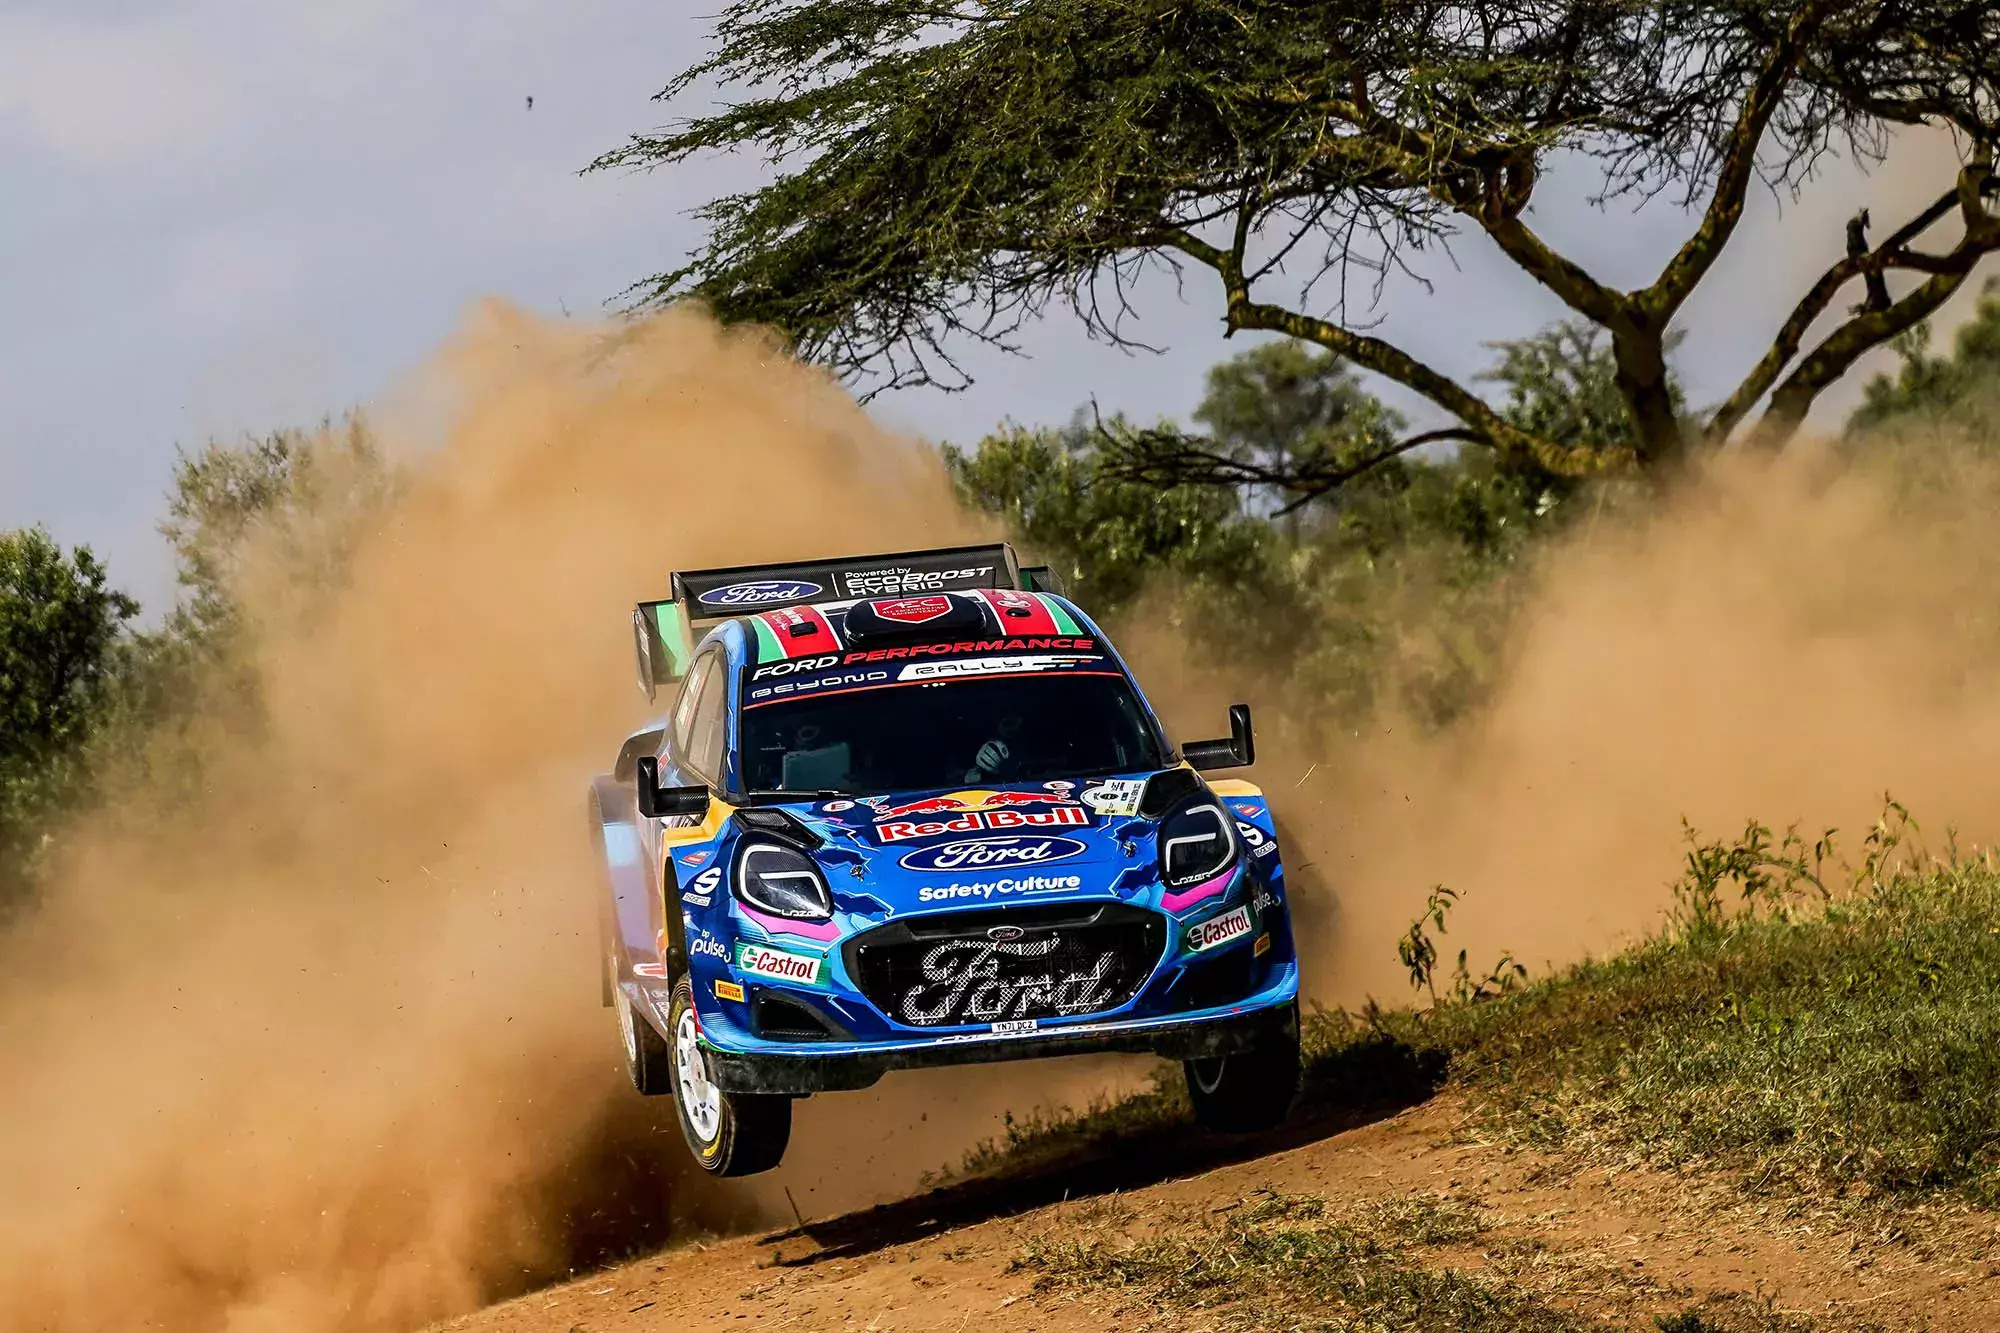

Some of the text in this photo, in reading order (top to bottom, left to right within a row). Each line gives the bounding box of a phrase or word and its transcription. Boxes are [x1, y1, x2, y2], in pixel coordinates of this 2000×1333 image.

[845, 567, 911, 578] Powered by
[845, 566, 994, 588] ECOBOOST
[720, 584, 800, 603] Ford
[850, 580, 944, 596] HYBRID
[752, 639, 1094, 681] FORD PERFORMANCE
[752, 660, 1023, 699] BEYOND RALLY
[876, 807, 1089, 842] Red Bull
[934, 838, 1053, 868] Ford
[919, 875, 1081, 902] SafetyCulture
[701, 928, 710, 938] bp
[1203, 910, 1250, 945] Castrol
[690, 936, 726, 959] pulse
[756, 951, 816, 980] Castrol
[903, 938, 1114, 1025] Ford
[996, 1021, 1033, 1031] YN71 DCZ
